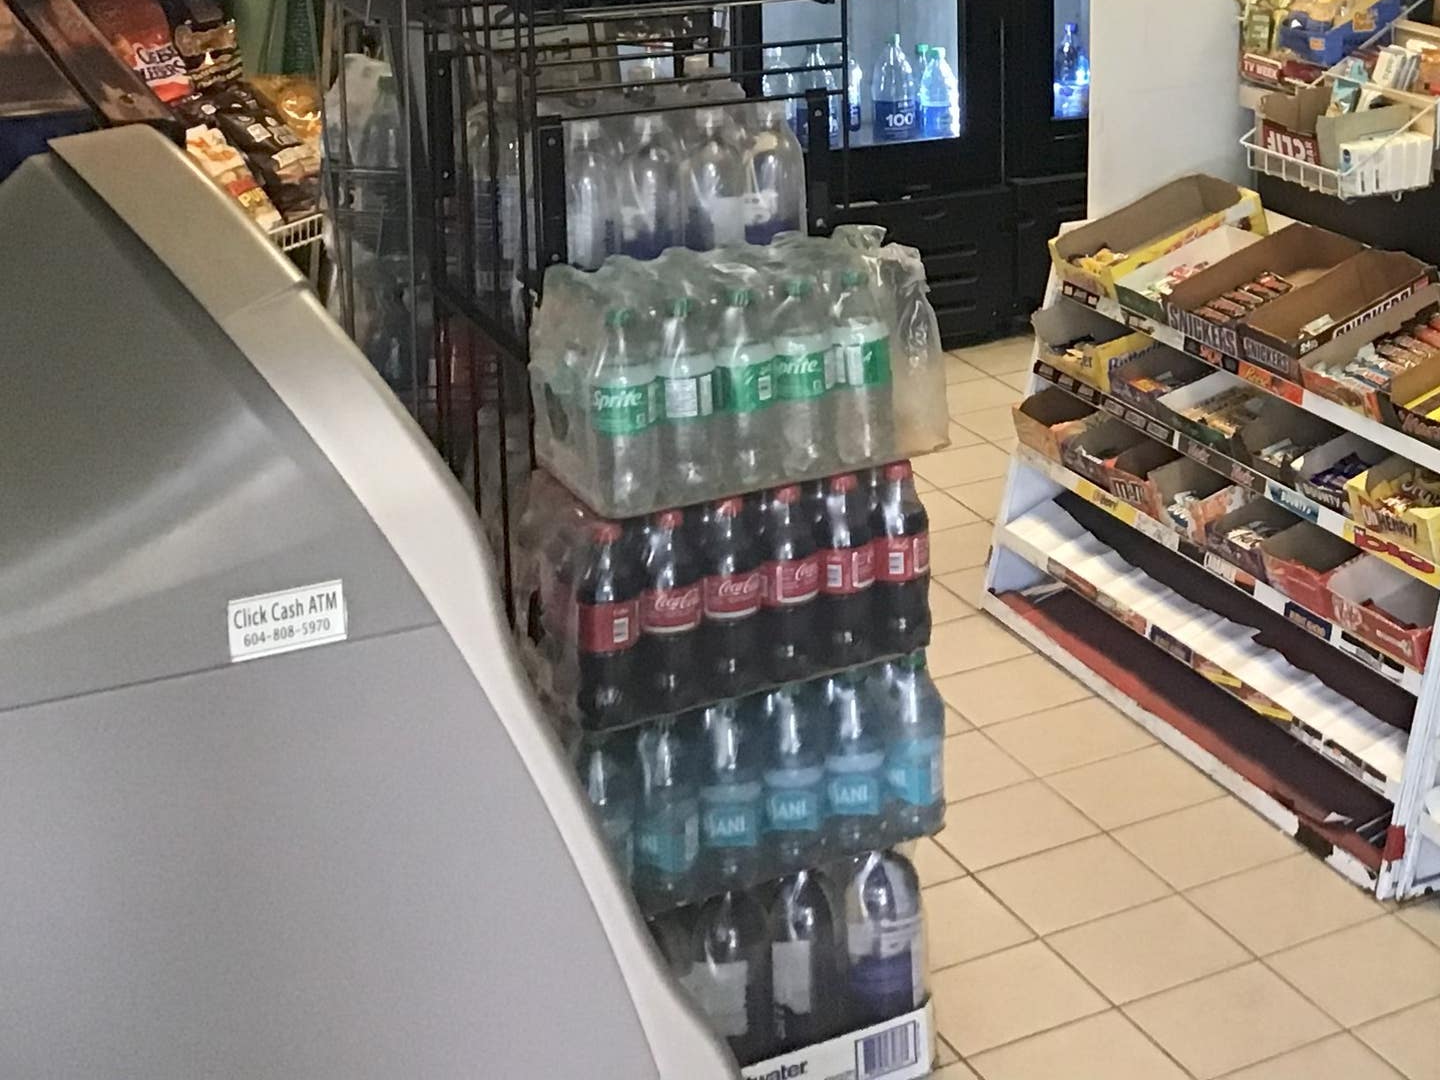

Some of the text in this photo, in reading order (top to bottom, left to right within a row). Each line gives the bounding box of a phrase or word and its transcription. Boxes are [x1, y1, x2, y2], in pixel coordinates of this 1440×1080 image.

[1167, 303, 1238, 358] SNICKERS
[1243, 336, 1290, 373] SNICKERS
[592, 387, 644, 410] Sprite
[233, 591, 338, 630] Click Cash ATM
[243, 618, 331, 648] 604-808-5970
